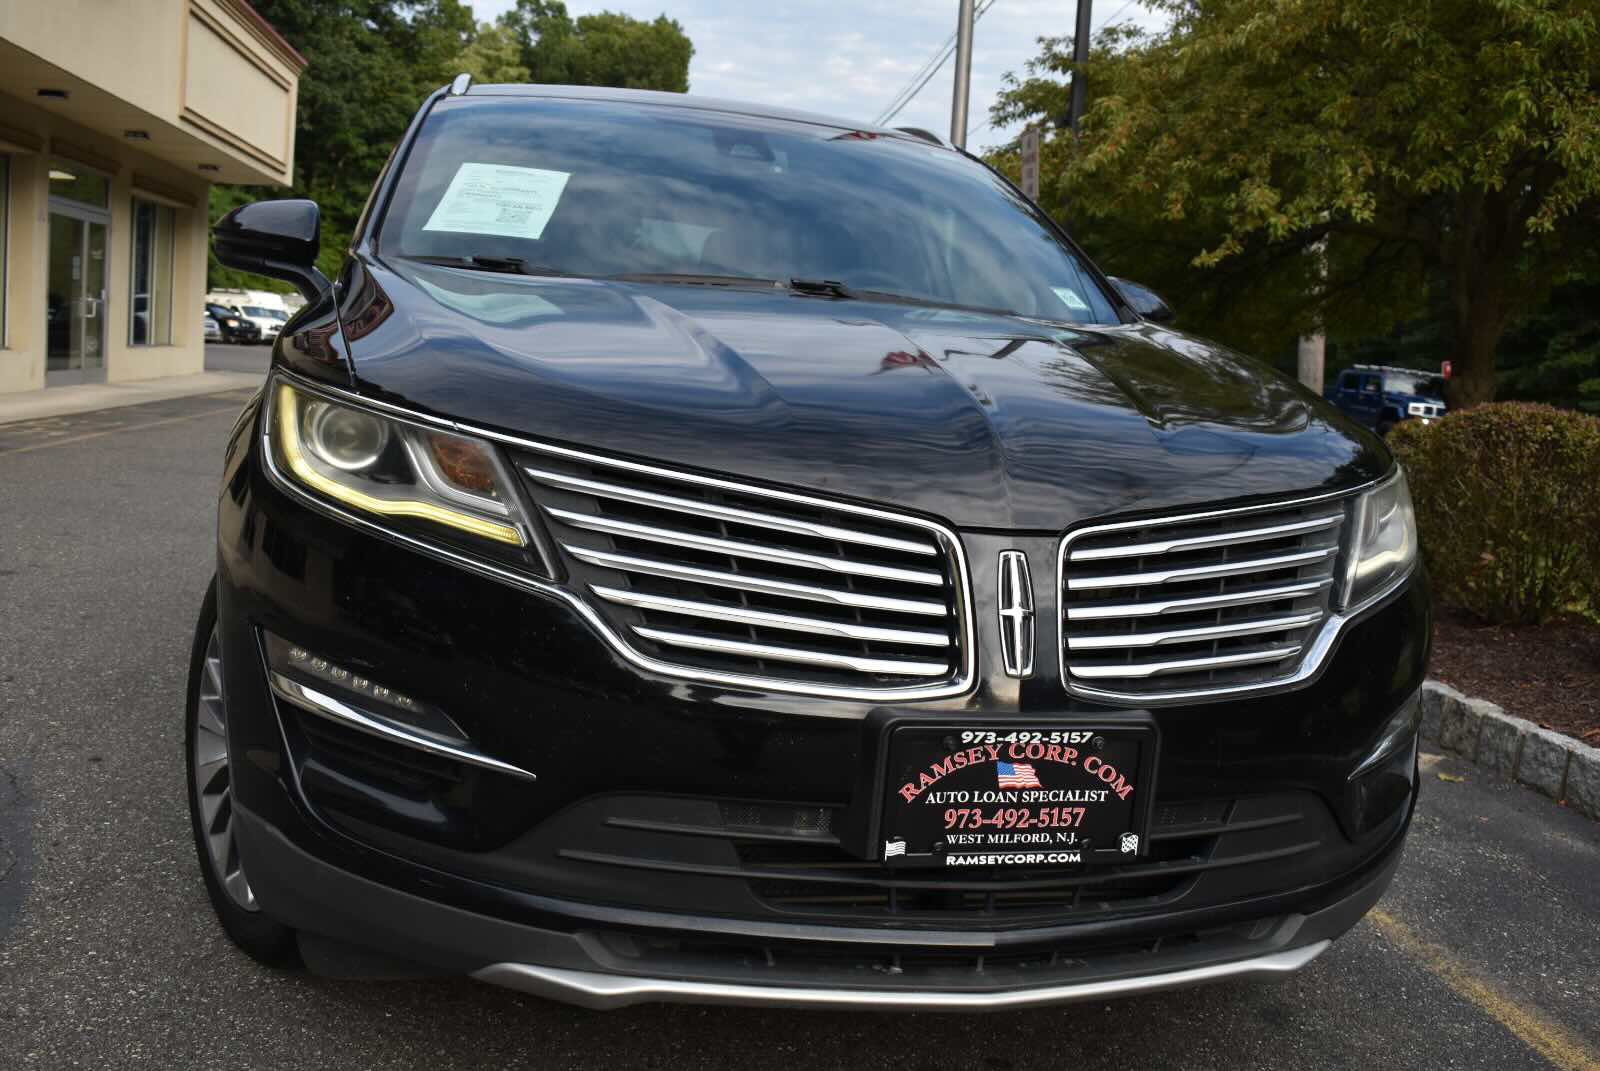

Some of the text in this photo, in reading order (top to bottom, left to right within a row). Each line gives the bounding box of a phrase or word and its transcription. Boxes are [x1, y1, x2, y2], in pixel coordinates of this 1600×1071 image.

[961, 731, 1093, 744] 973-492-5157
[899, 743, 1134, 803] RAMSEY CORP. COM
[925, 790, 1108, 804] AUTO LOAN SPECIALIST
[944, 807, 1086, 829] 973-492-5157
[946, 833, 1078, 845] WEST MILFORD, N.J.
[946, 853, 1081, 866] RAMSEYCORP.COM
